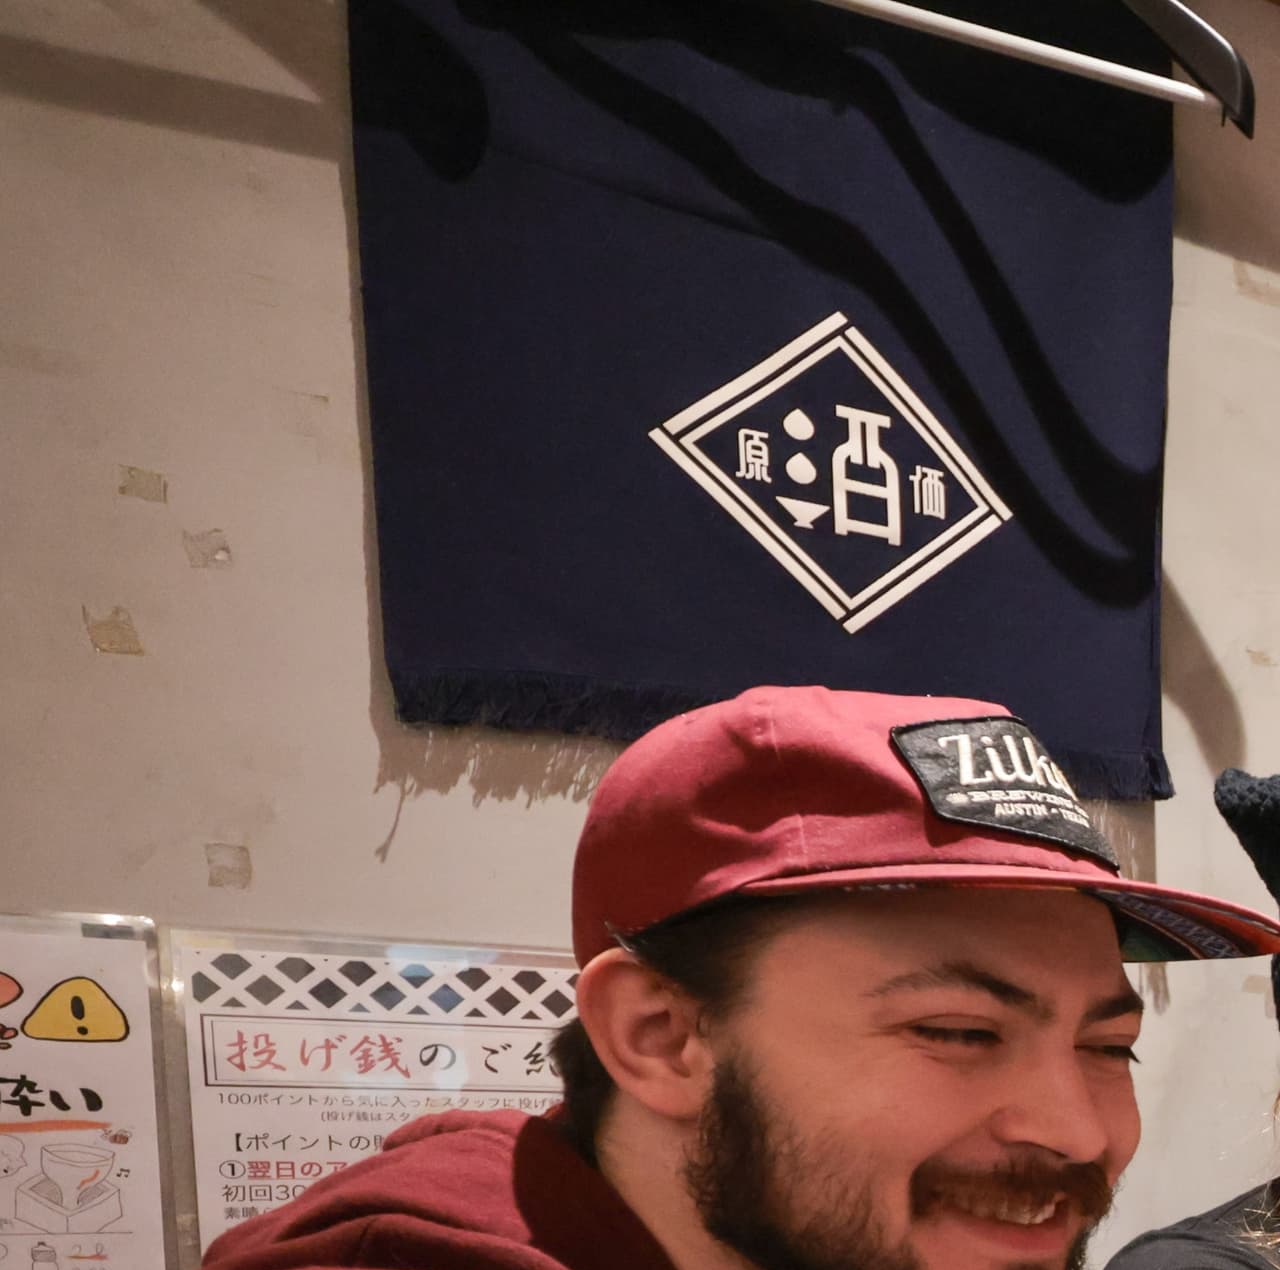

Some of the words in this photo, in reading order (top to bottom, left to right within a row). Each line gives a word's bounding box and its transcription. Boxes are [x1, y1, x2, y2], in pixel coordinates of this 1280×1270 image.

[735, 428, 772, 484] 原
[909, 465, 946, 520] 価
[938, 734, 1079, 802] Zilk
[995, 803, 1049, 817] AUSTIN
